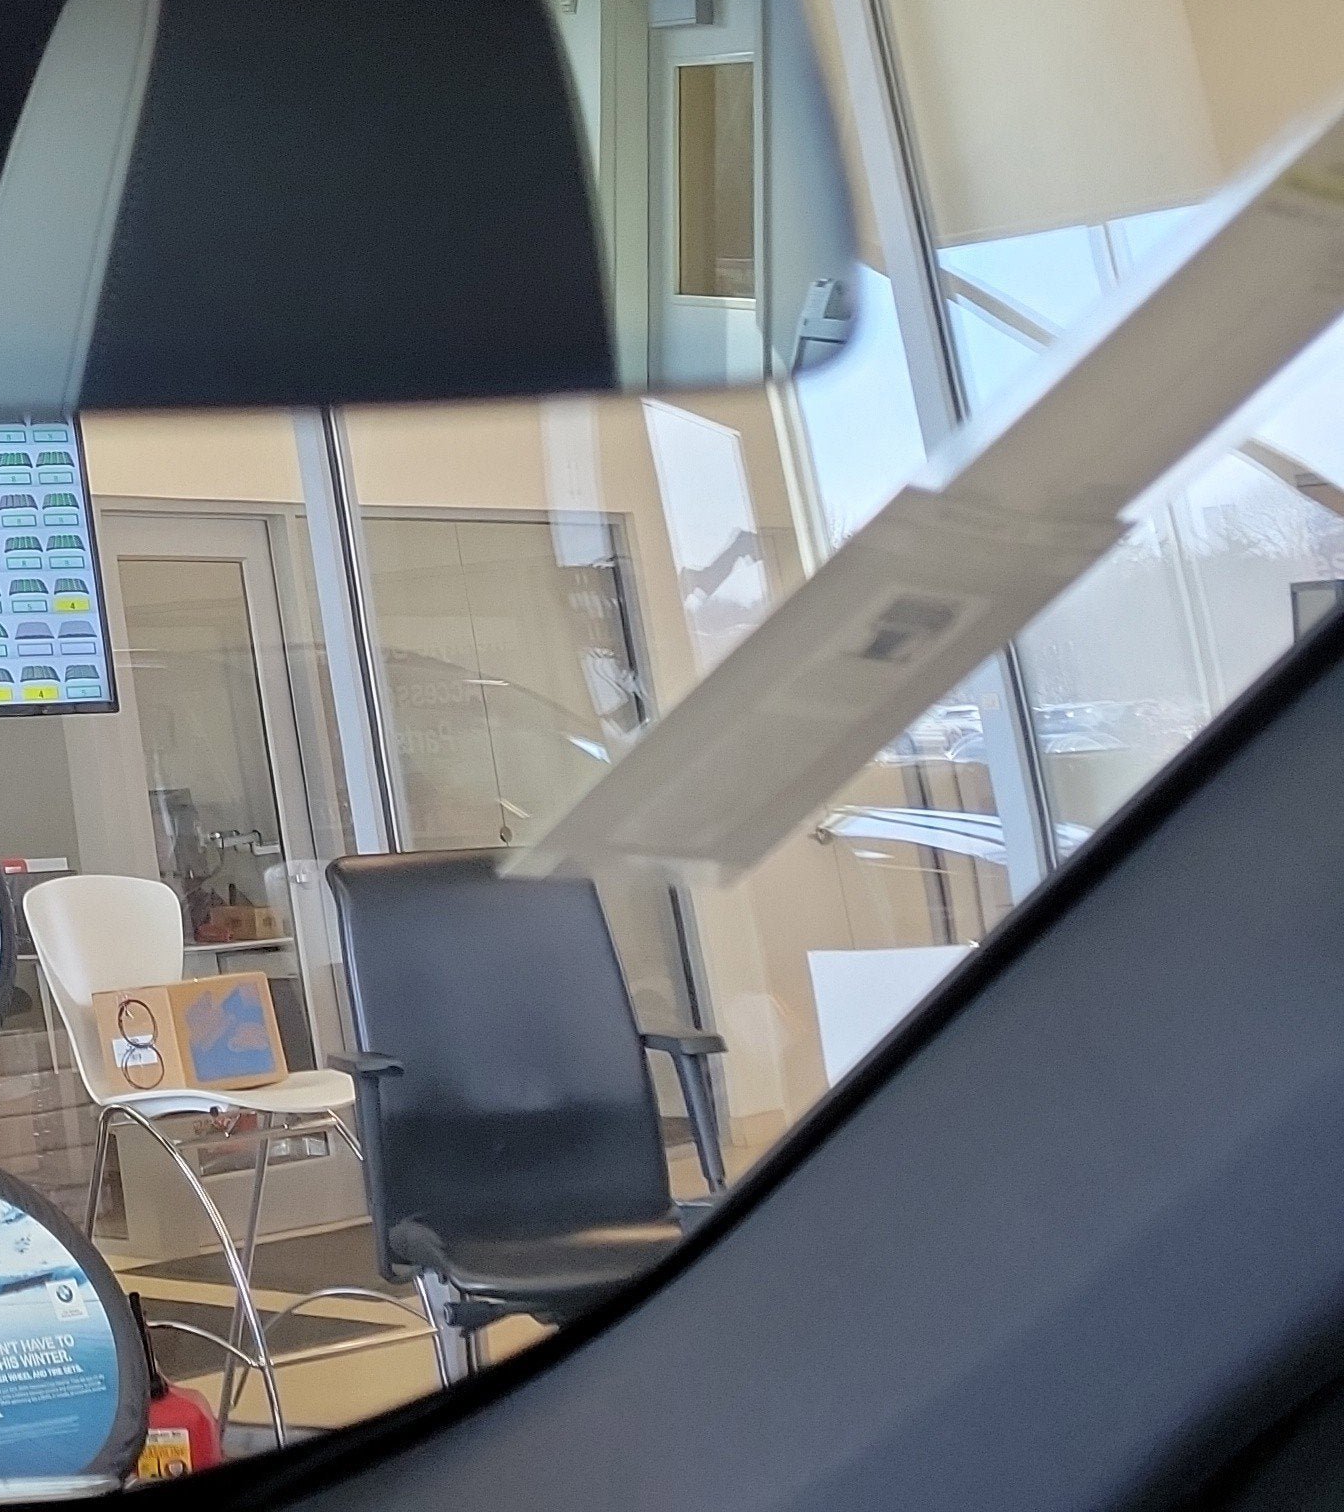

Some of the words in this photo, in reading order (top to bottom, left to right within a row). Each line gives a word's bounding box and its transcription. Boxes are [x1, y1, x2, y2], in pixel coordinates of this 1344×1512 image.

[20, 1335, 56, 1353] HAVE
[55, 1334, 75, 1348] TO
[19, 1349, 73, 1368] WINTER.
[7, 1372, 33, 1383] WHEEL
[32, 1369, 48, 1379] AND
[47, 1367, 64, 1377] TIRE
